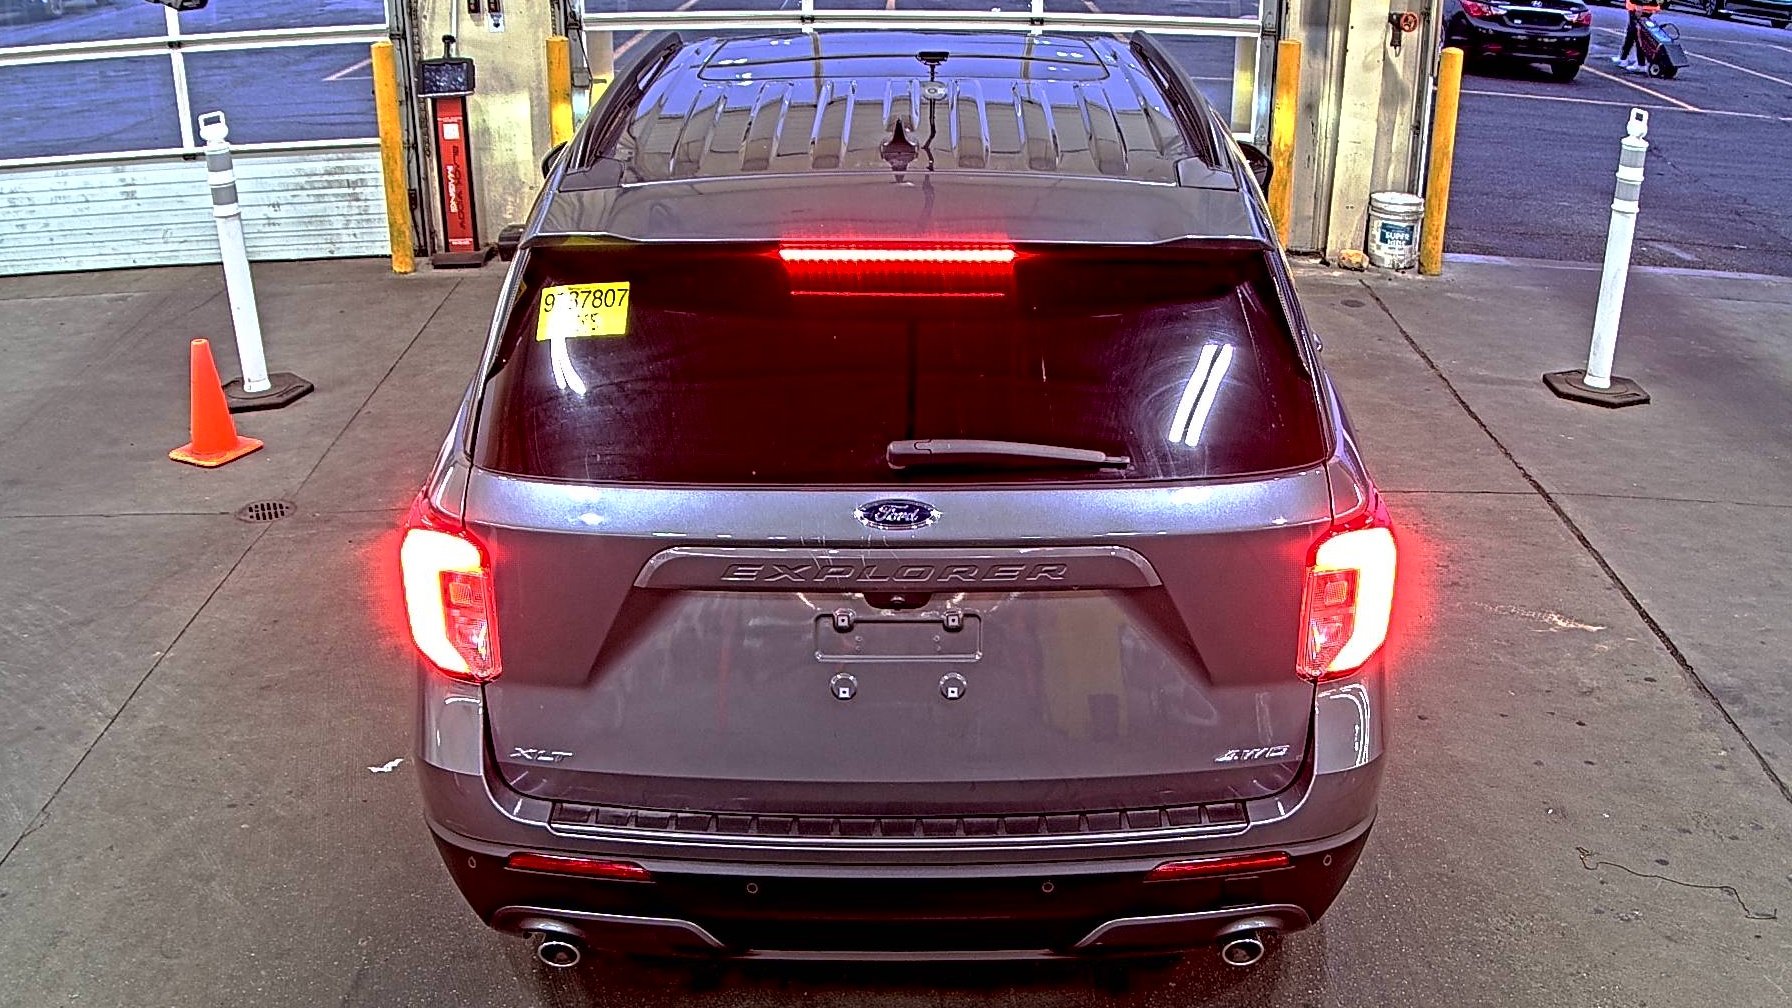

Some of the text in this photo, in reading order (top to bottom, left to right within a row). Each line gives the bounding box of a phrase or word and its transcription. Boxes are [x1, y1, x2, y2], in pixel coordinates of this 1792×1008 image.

[446, 165, 458, 213] IMAGING
[543, 288, 628, 312] 937807
[875, 504, 919, 522] Ford
[720, 563, 1068, 583] EXPLORER
[509, 747, 573, 762] XLT
[1214, 744, 1290, 762] 4WD
